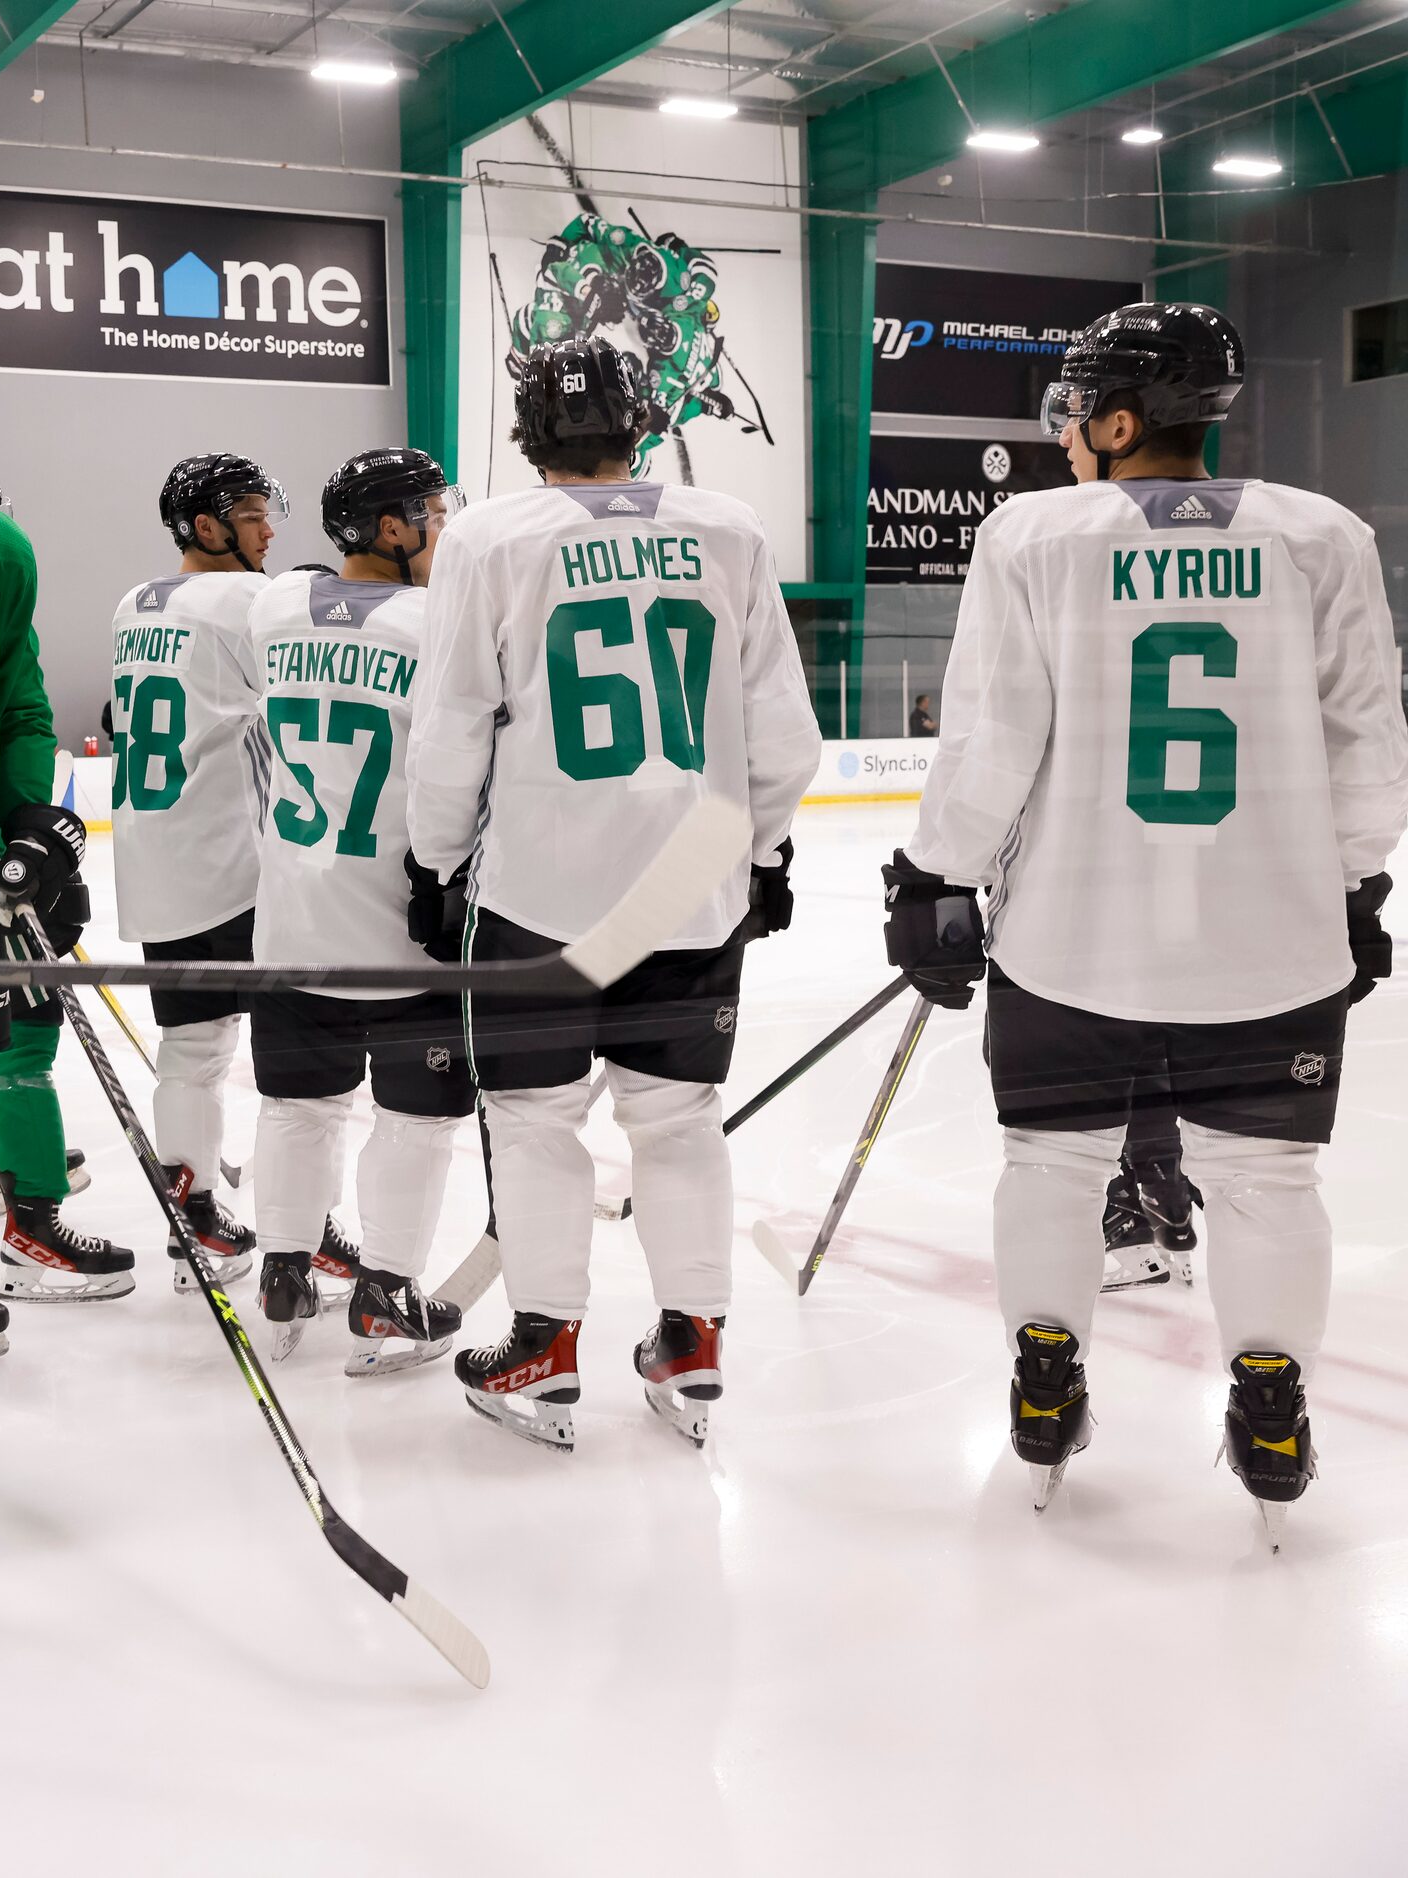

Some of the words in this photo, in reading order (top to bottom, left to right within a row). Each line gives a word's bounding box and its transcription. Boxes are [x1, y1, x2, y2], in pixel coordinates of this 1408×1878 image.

[100, 327, 138, 346] The
[143, 329, 200, 349] Home
[204, 331, 261, 352] Décor
[264, 335, 364, 358] Superstore
[943, 321, 1034, 341] MICHAEL
[1226, 349, 1236, 374] 6
[563, 374, 586, 393] 60
[608, 502, 641, 512] adidas
[1170, 510, 1212, 520] adidas
[561, 537, 702, 588] HOLMES
[919, 562, 955, 576] OFFICIAL
[1113, 547, 1261, 601] KYROU
[326, 612, 352, 621] adidas
[546, 596, 717, 781] 60
[1126, 622, 1238, 825] 6
[864, 754, 928, 776] Slync.io
[267, 696, 394, 858] 57
[1298, 1061, 1320, 1076] NHL
[218, 1228, 237, 1240] CCM
[7, 1231, 75, 1271] CCM
[486, 1358, 553, 1393] CCM
